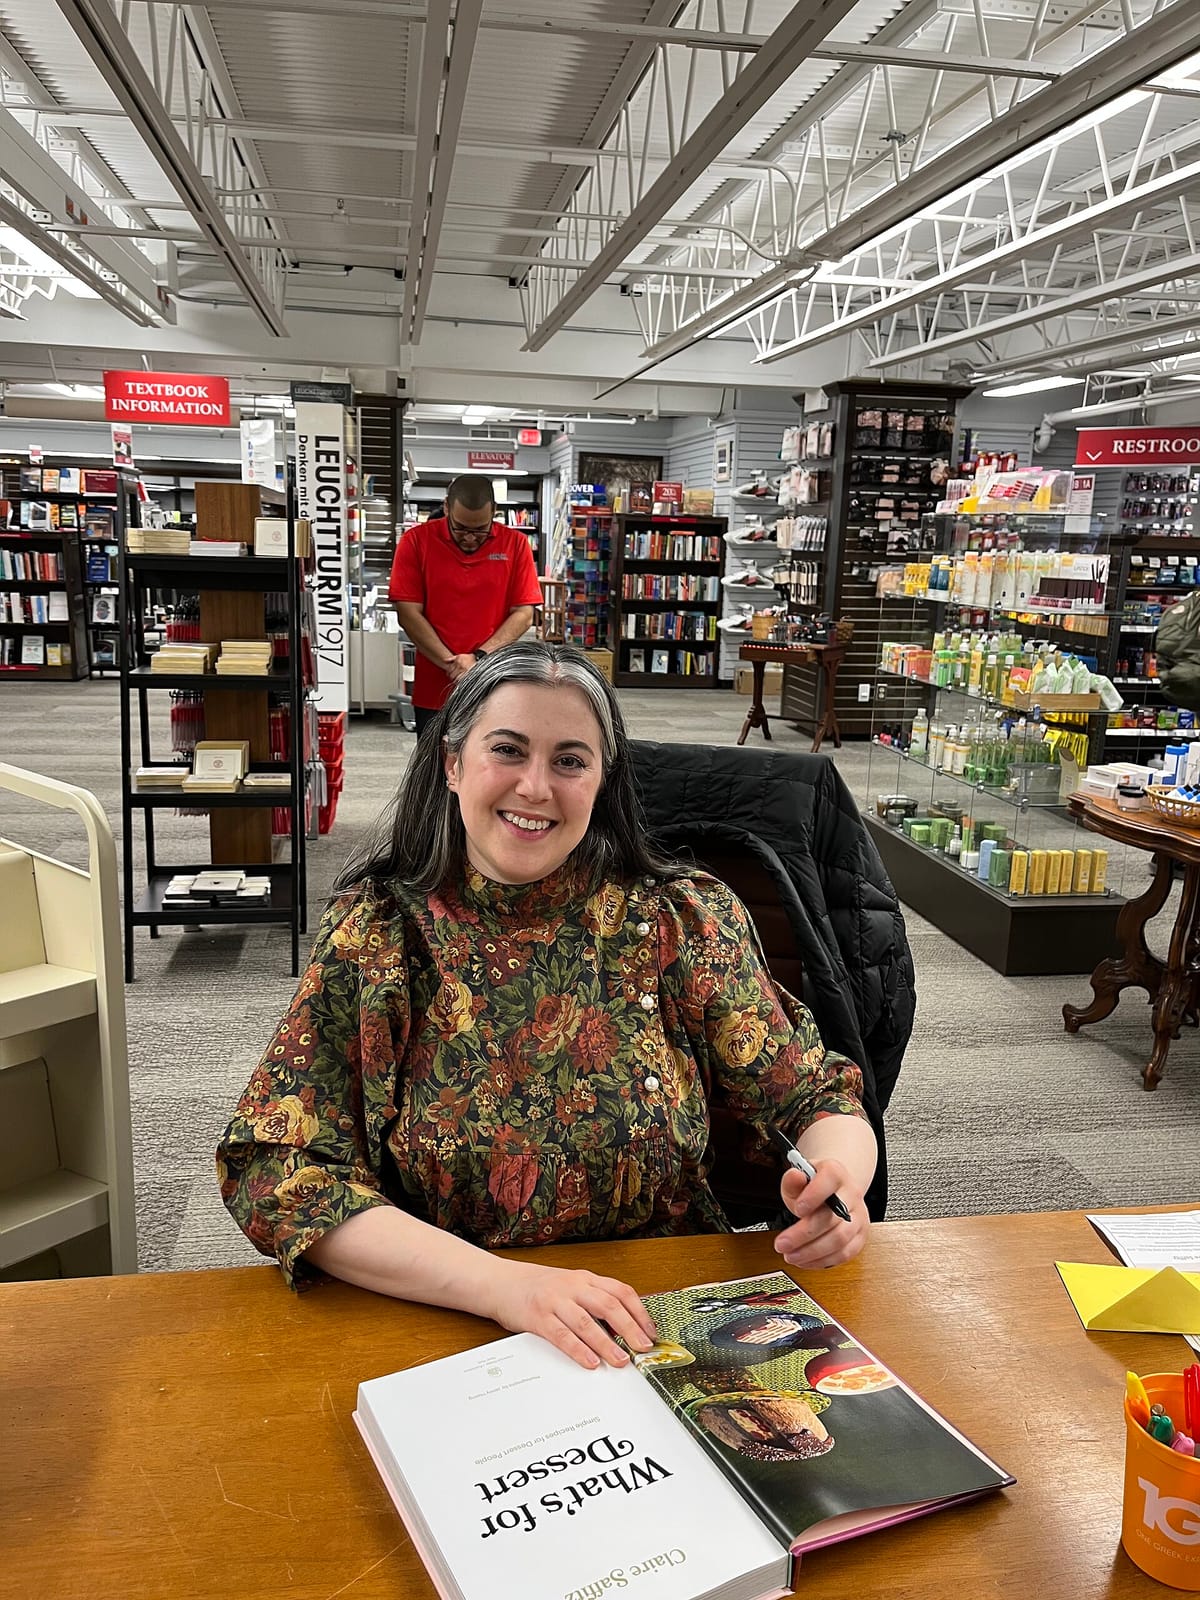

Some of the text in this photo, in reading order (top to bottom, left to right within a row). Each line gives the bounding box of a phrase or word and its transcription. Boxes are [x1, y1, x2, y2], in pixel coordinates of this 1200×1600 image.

[111, 398, 223, 416] INFORMATION
[125, 382, 209, 398] TEXTBOOK
[299, 434, 309, 482] Denken
[471, 452, 512, 461] ELEVATOR
[1112, 439, 1200, 454] RESTROO
[300, 486, 309, 506] mit
[315, 435, 343, 667] LEUCHTTURM1917
[475, 1416, 601, 1465] Simple Recipes for Dessert People
[474, 1435, 634, 1503] Dessert
[481, 1456, 674, 1538] What's for
[564, 1548, 686, 1600] Claire Saffitz
